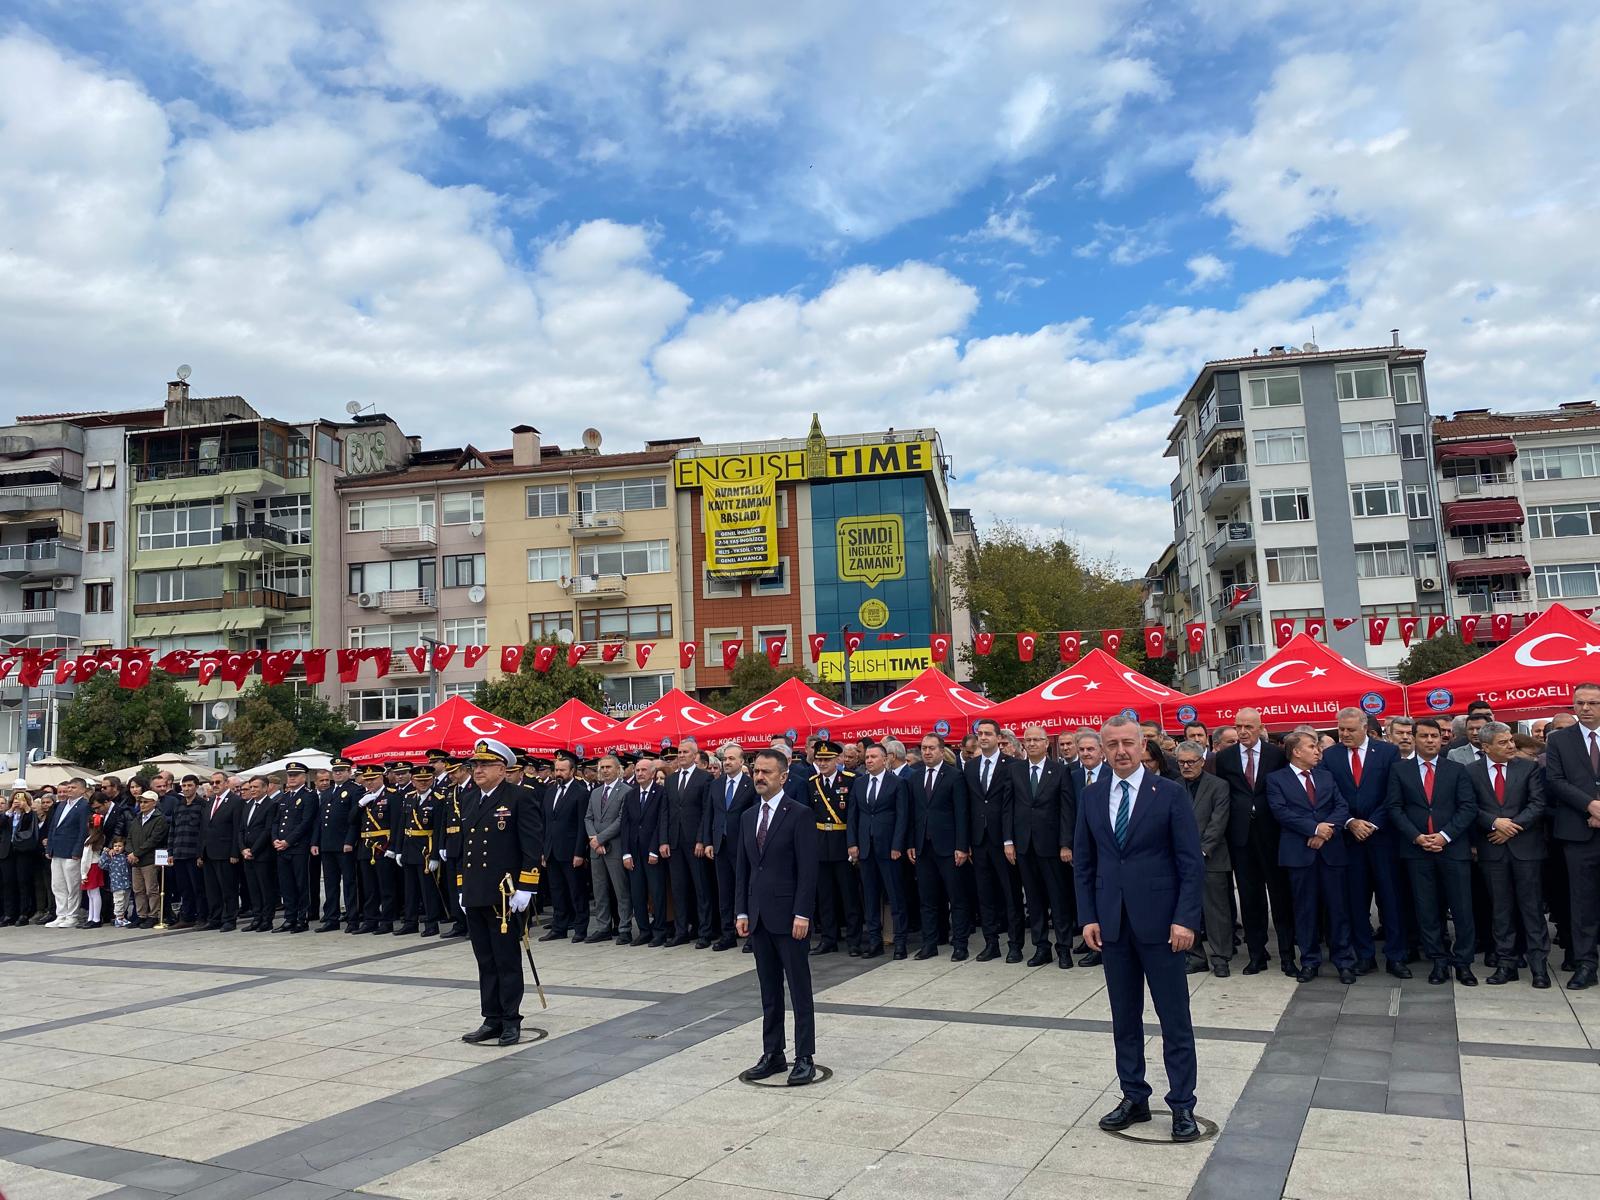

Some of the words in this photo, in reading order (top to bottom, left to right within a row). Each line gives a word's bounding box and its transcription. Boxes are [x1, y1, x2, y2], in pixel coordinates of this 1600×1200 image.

[679, 453, 805, 486] ENGLISH
[829, 444, 922, 475] TIME
[714, 484, 764, 498] AVANTAJLI
[708, 499, 734, 511] KAYIT
[735, 496, 771, 510] ZAMANI
[720, 510, 760, 524] BAŞLADI
[849, 556, 894, 570] ZAMANI
[821, 658, 887, 674] ENGLISH
[888, 656, 929, 672] TIME
[1477, 692, 1502, 703] T.C.
[1505, 683, 1570, 700] KOCAELİ
[1216, 709, 1236, 719] T.C.
[1290, 701, 1340, 713] VALİLİĞİ
[1003, 723, 1020, 731] T.C.
[1021, 716, 1062, 729] KOCAELİ
[1063, 714, 1103, 726] VALİLİĞİ
[856, 726, 890, 738] KOCAELİ
[890, 725, 922, 735] VALİLİĞİ
[706, 739, 717, 747] T.C.
[718, 735, 747, 745] KOCAELİ
[747, 734, 774, 743] VALİLİĞ
[593, 747, 604, 755] T.C.
[628, 741, 652, 751] VALİLİĞİ
